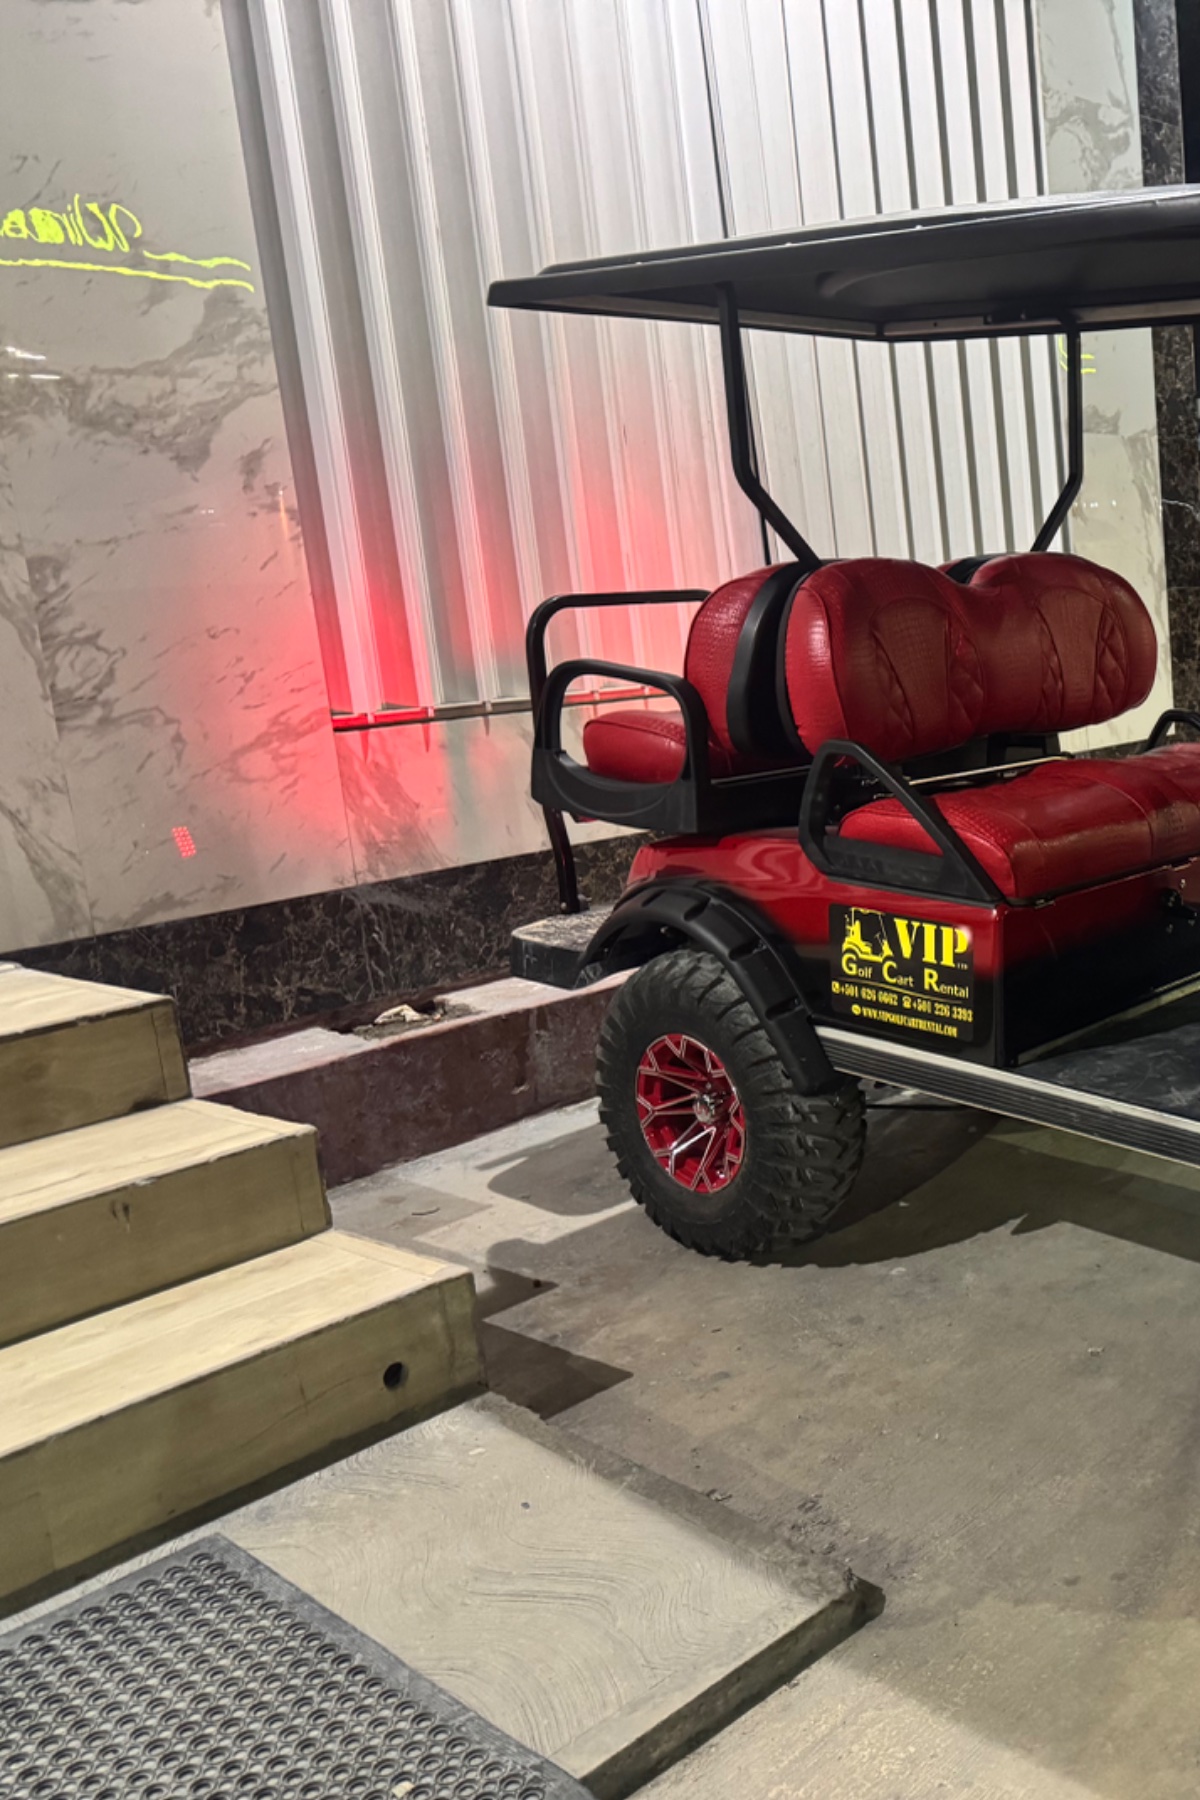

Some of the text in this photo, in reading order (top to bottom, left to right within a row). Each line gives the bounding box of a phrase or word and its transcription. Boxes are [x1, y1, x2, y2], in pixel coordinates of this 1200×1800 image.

[893, 917, 971, 967] VIP
[842, 952, 969, 998] Golf Cart Rental
